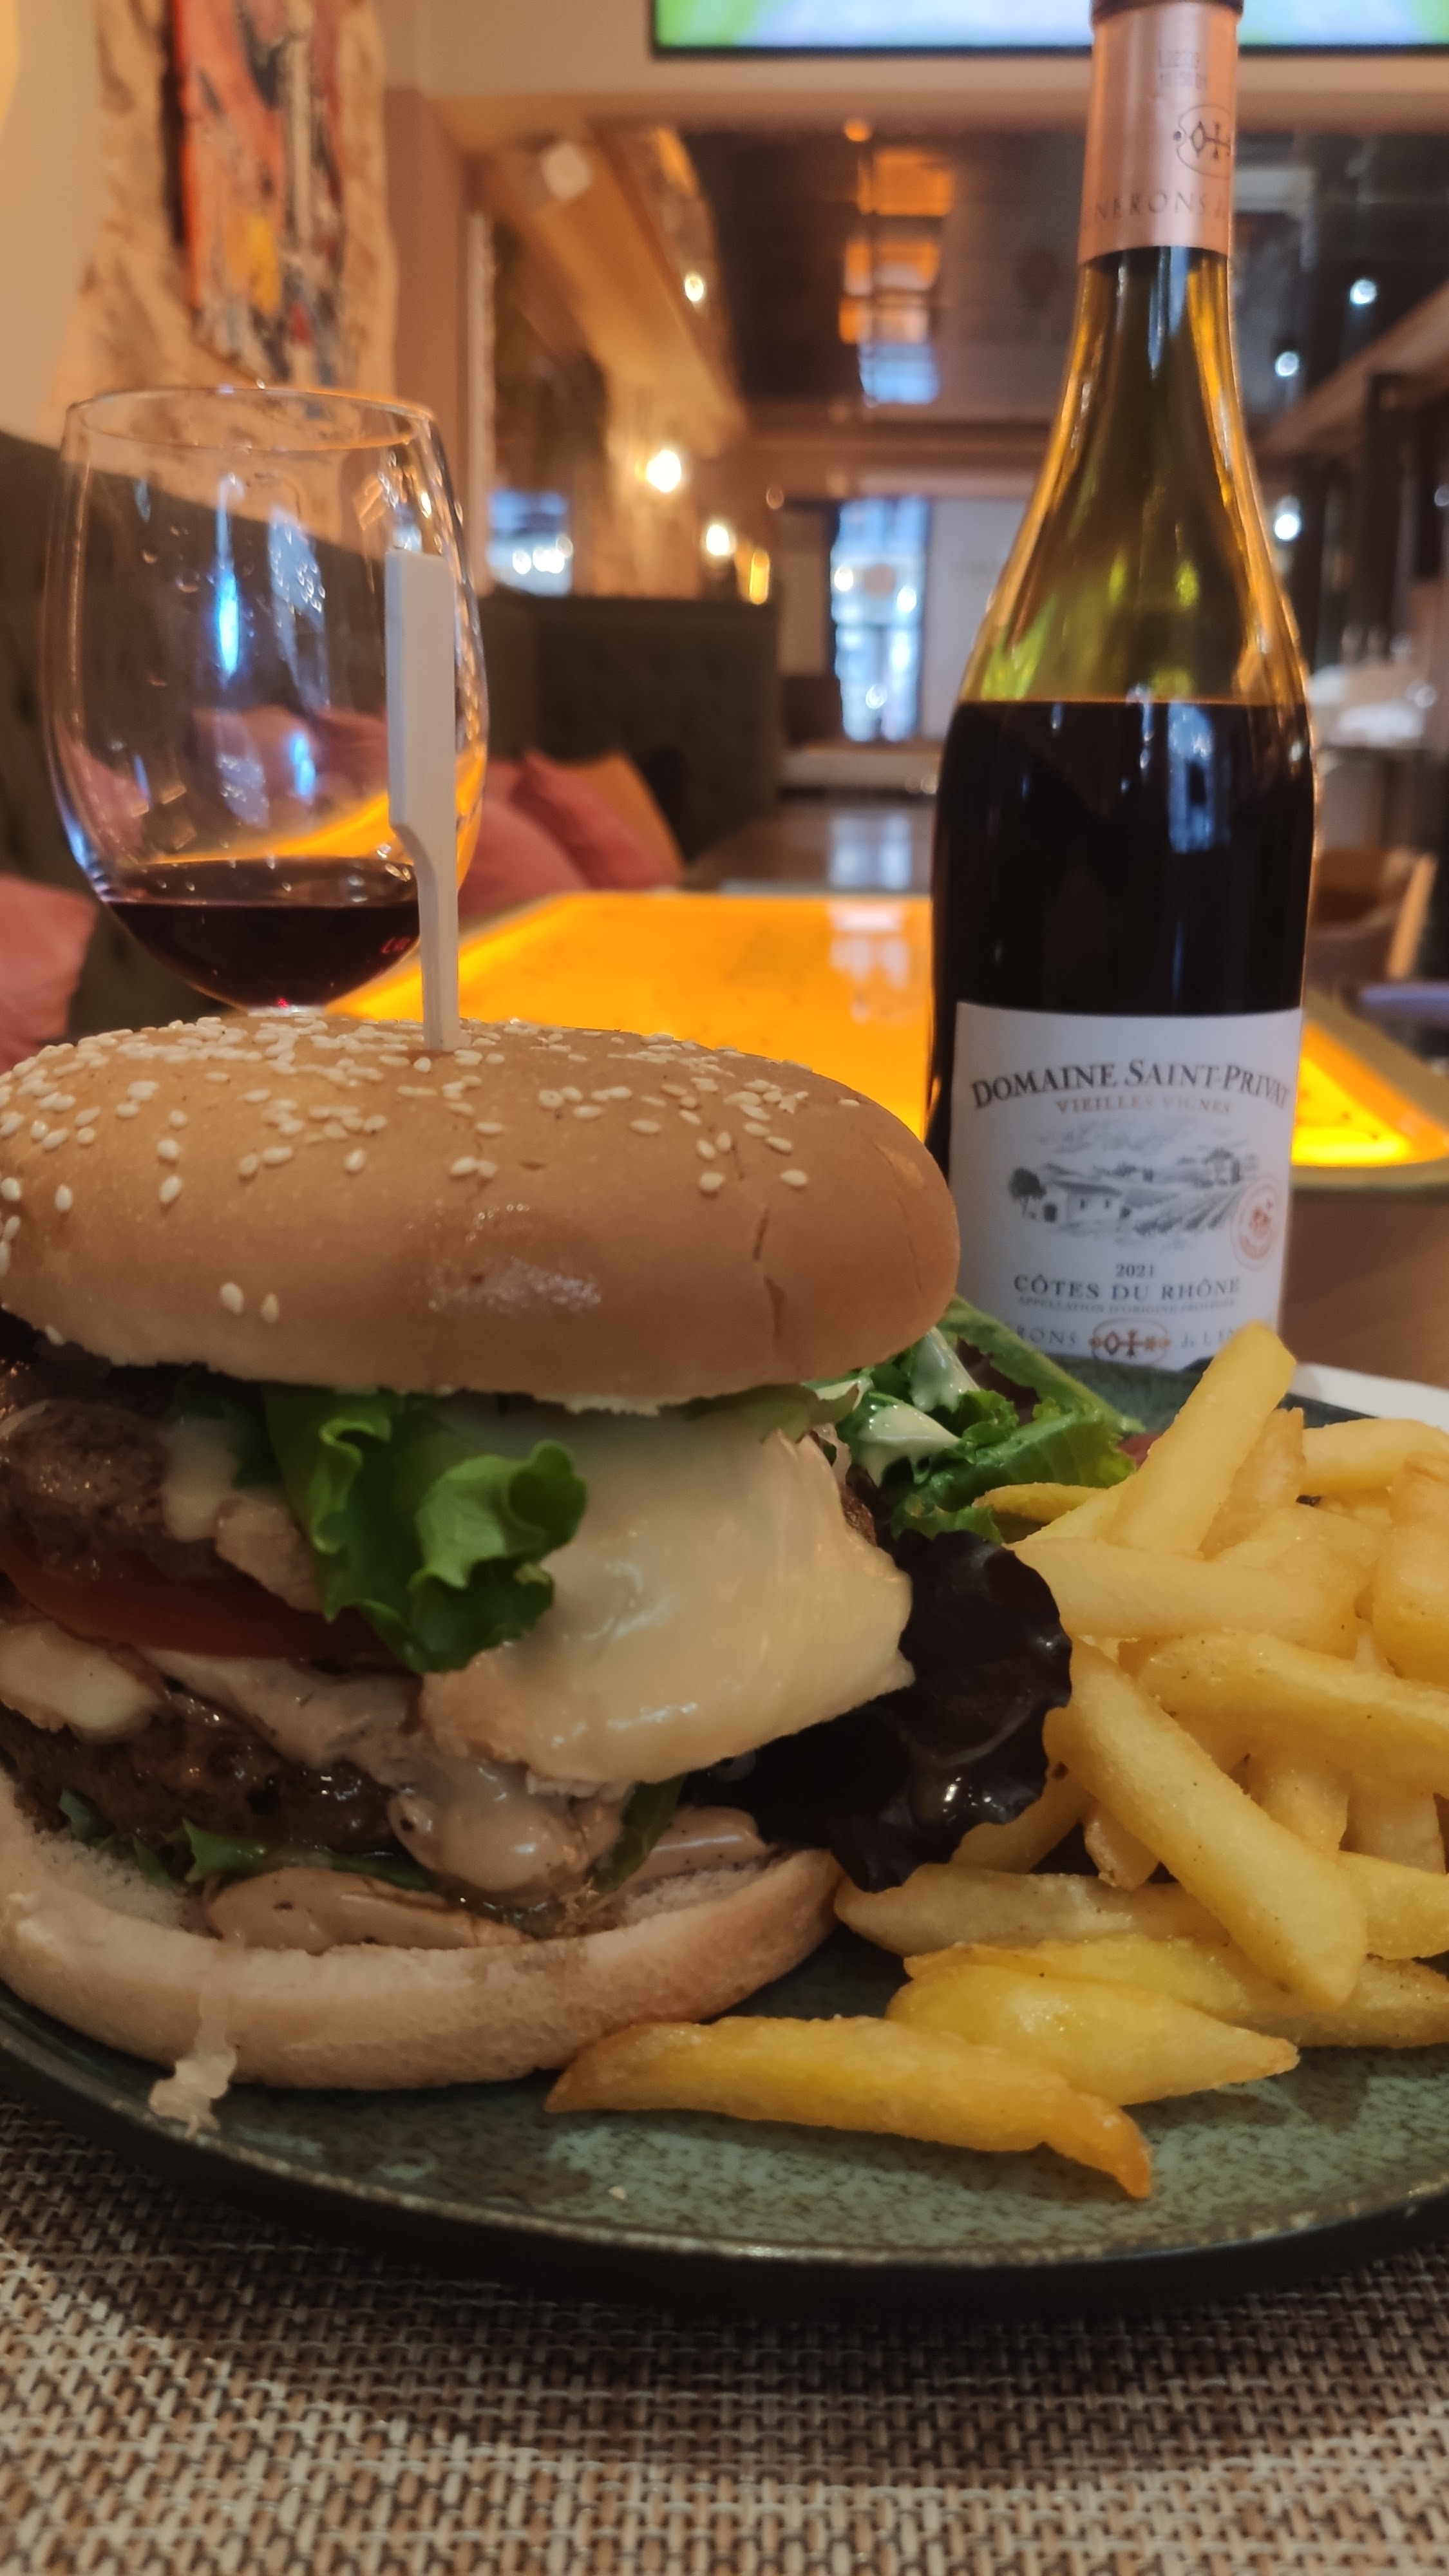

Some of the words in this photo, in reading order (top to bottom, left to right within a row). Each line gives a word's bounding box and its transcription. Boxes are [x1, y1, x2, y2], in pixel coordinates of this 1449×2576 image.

[970, 1063, 1118, 1109] DOMAINE
[1124, 1057, 1289, 1109] SAINT-PRIVAT
[1056, 1096, 1153, 1113] VIEILLES
[1162, 1096, 1231, 1115] VIGNES
[1115, 1264, 1154, 1278] 2021
[1014, 1274, 1100, 1300] CÔTES
[1111, 1282, 1149, 1302] DU
[1161, 1276, 1239, 1301] RHÔNE
